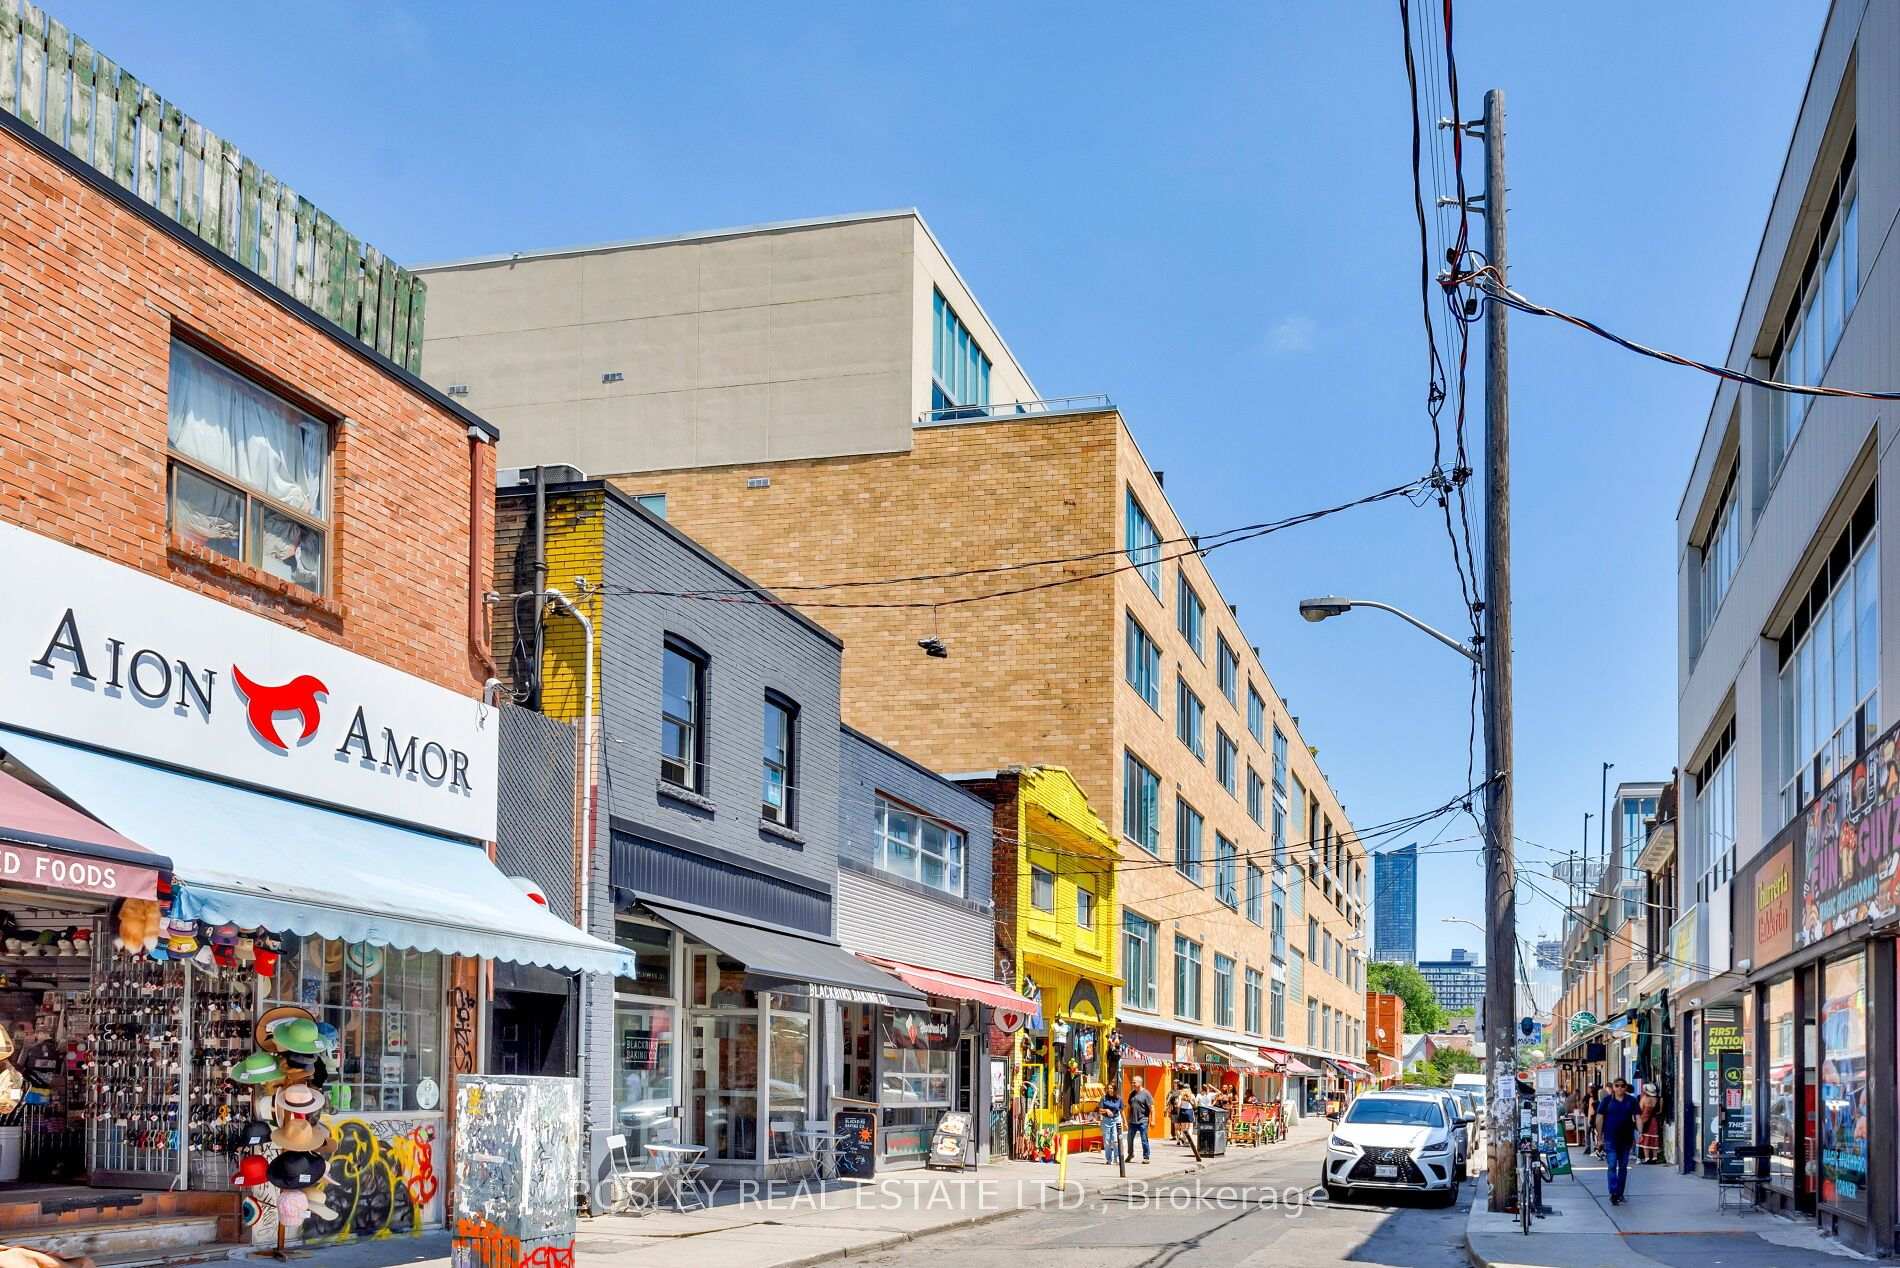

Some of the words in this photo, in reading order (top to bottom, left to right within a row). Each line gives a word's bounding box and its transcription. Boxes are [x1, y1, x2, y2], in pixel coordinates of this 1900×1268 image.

[32, 608, 217, 715] AION
[336, 705, 473, 791] AMOR
[0, 851, 20, 874] D
[35, 857, 117, 889] FOODS
[809, 983, 851, 1001] BLACKBIRD
[852, 990, 877, 1003] BAKING
[1709, 1027, 1737, 1036] FIRST
